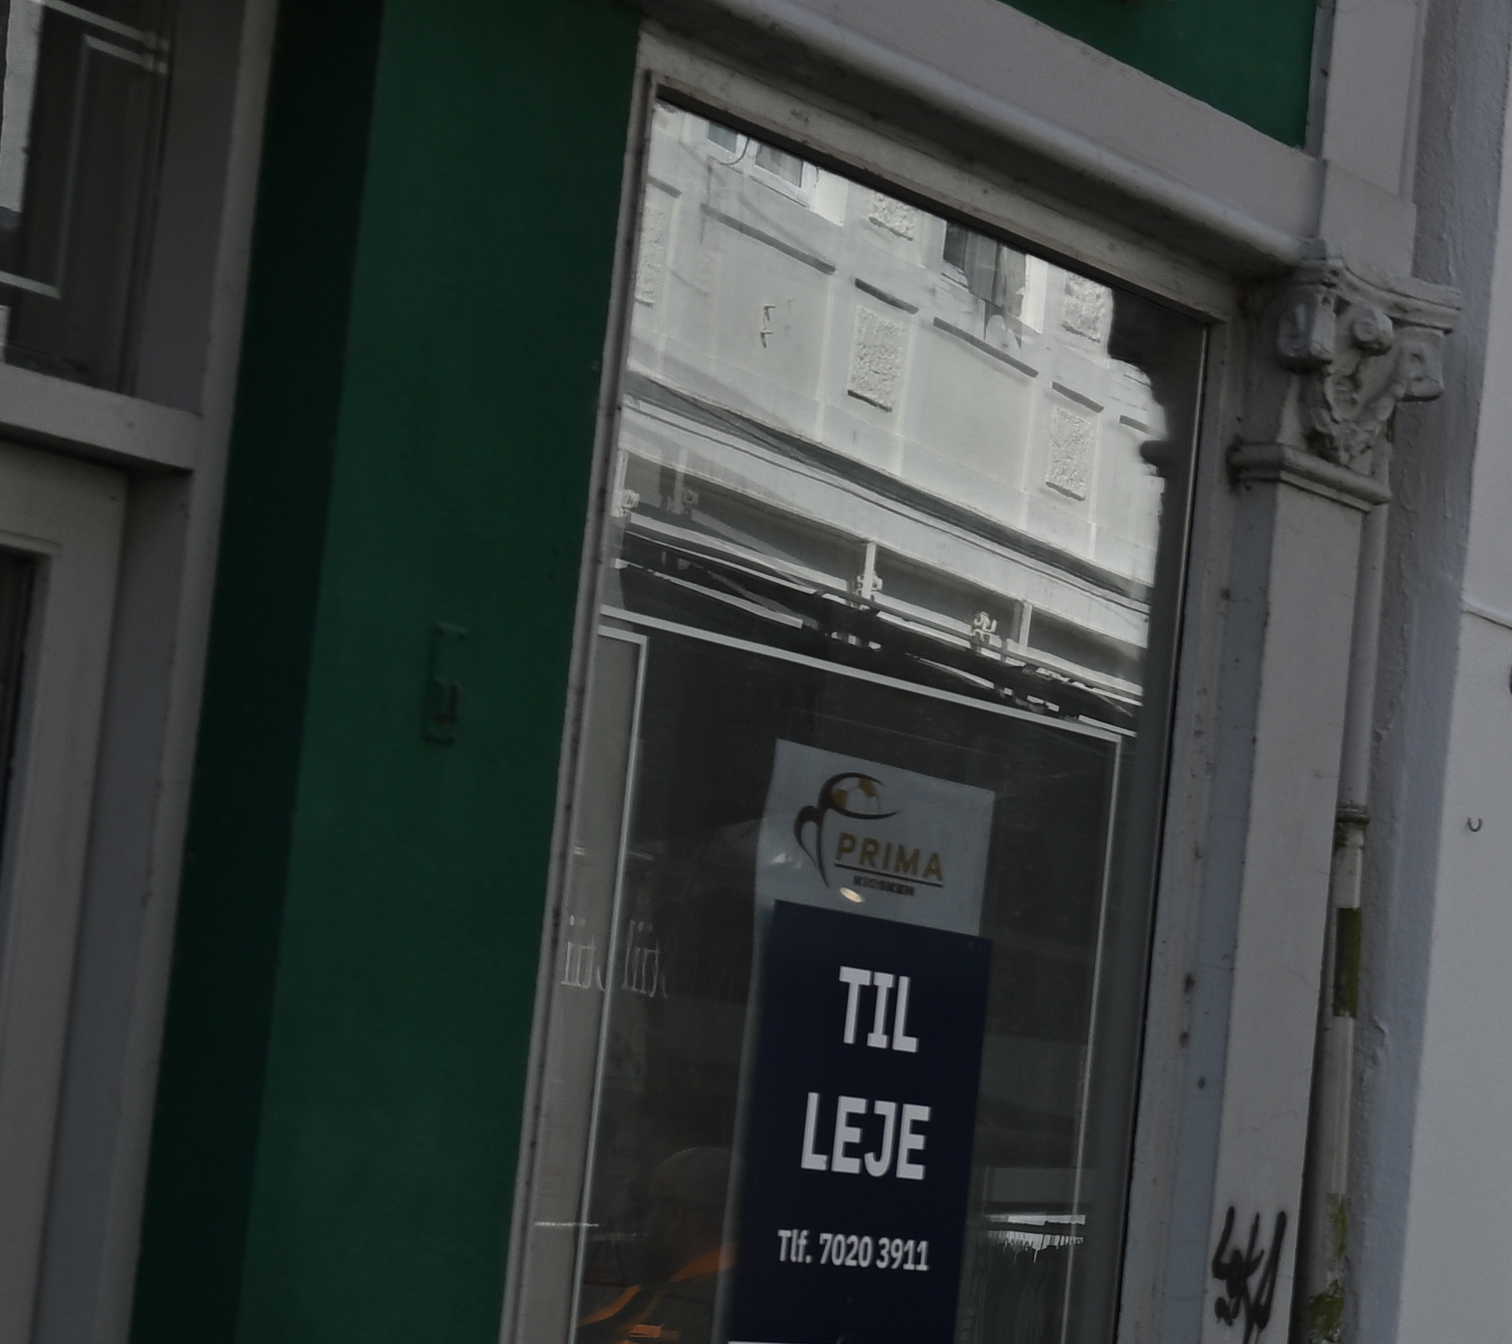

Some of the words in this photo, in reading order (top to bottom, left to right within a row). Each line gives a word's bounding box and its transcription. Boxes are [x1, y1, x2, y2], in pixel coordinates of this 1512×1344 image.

[837, 831, 944, 881] PRIMA
[838, 965, 920, 1055] TIL
[800, 1091, 932, 1181] LEJE
[778, 1229, 813, 1264] Tlf.
[819, 1232, 874, 1268] 7020
[876, 1236, 930, 1272] 3911
